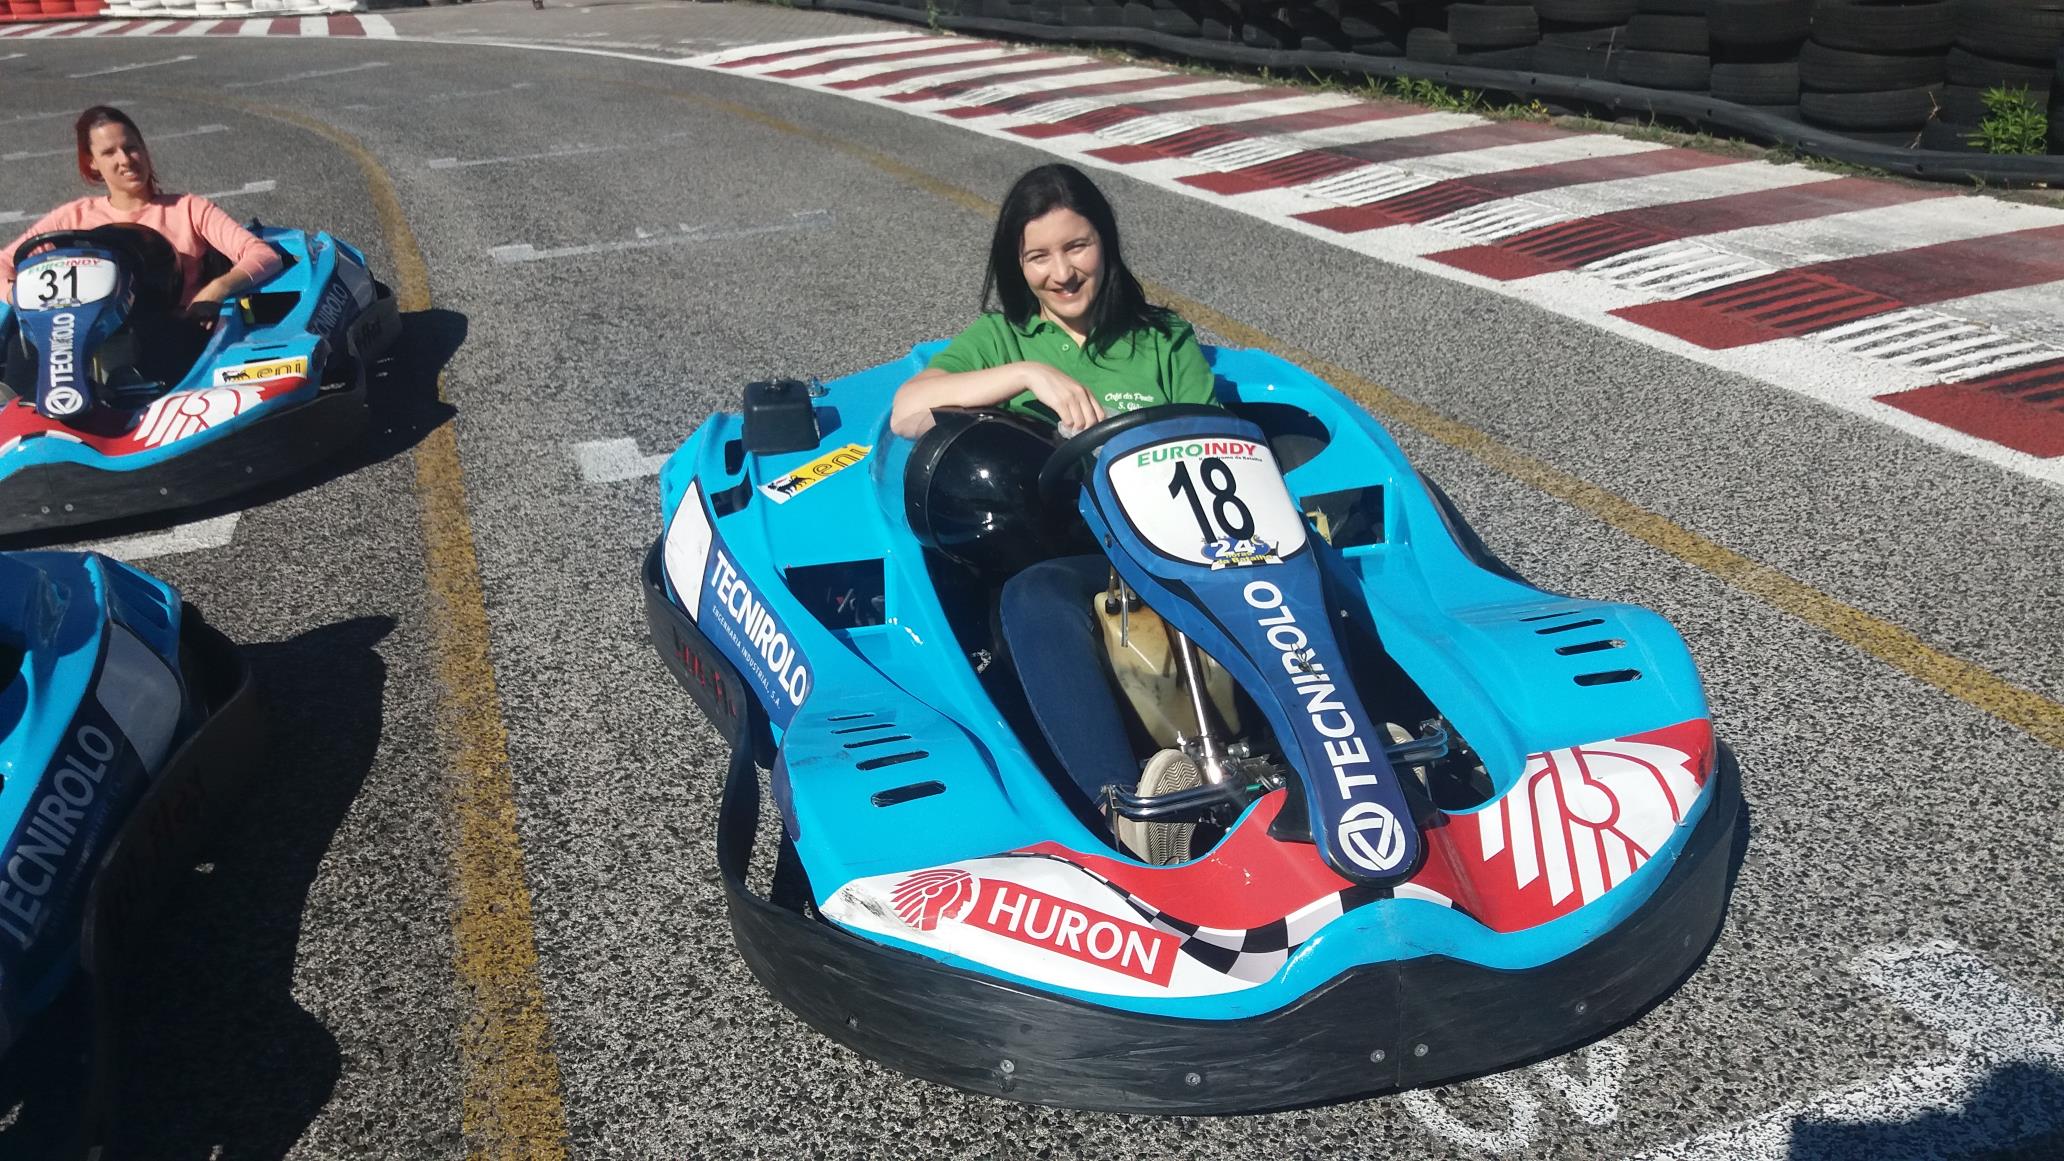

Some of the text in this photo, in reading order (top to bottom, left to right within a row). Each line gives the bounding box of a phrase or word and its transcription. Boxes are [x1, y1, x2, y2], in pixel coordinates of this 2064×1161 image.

[38, 266, 78, 302] 31
[257, 360, 301, 379] eni
[813, 446, 869, 476] eni
[1137, 443, 1257, 468] EUROINDY
[1168, 457, 1255, 543] 18
[1210, 539, 1256, 558] 24
[710, 550, 809, 707] TECNIROLO
[1243, 580, 1379, 800] TECNIROLO
[987, 886, 1161, 975] HURON
